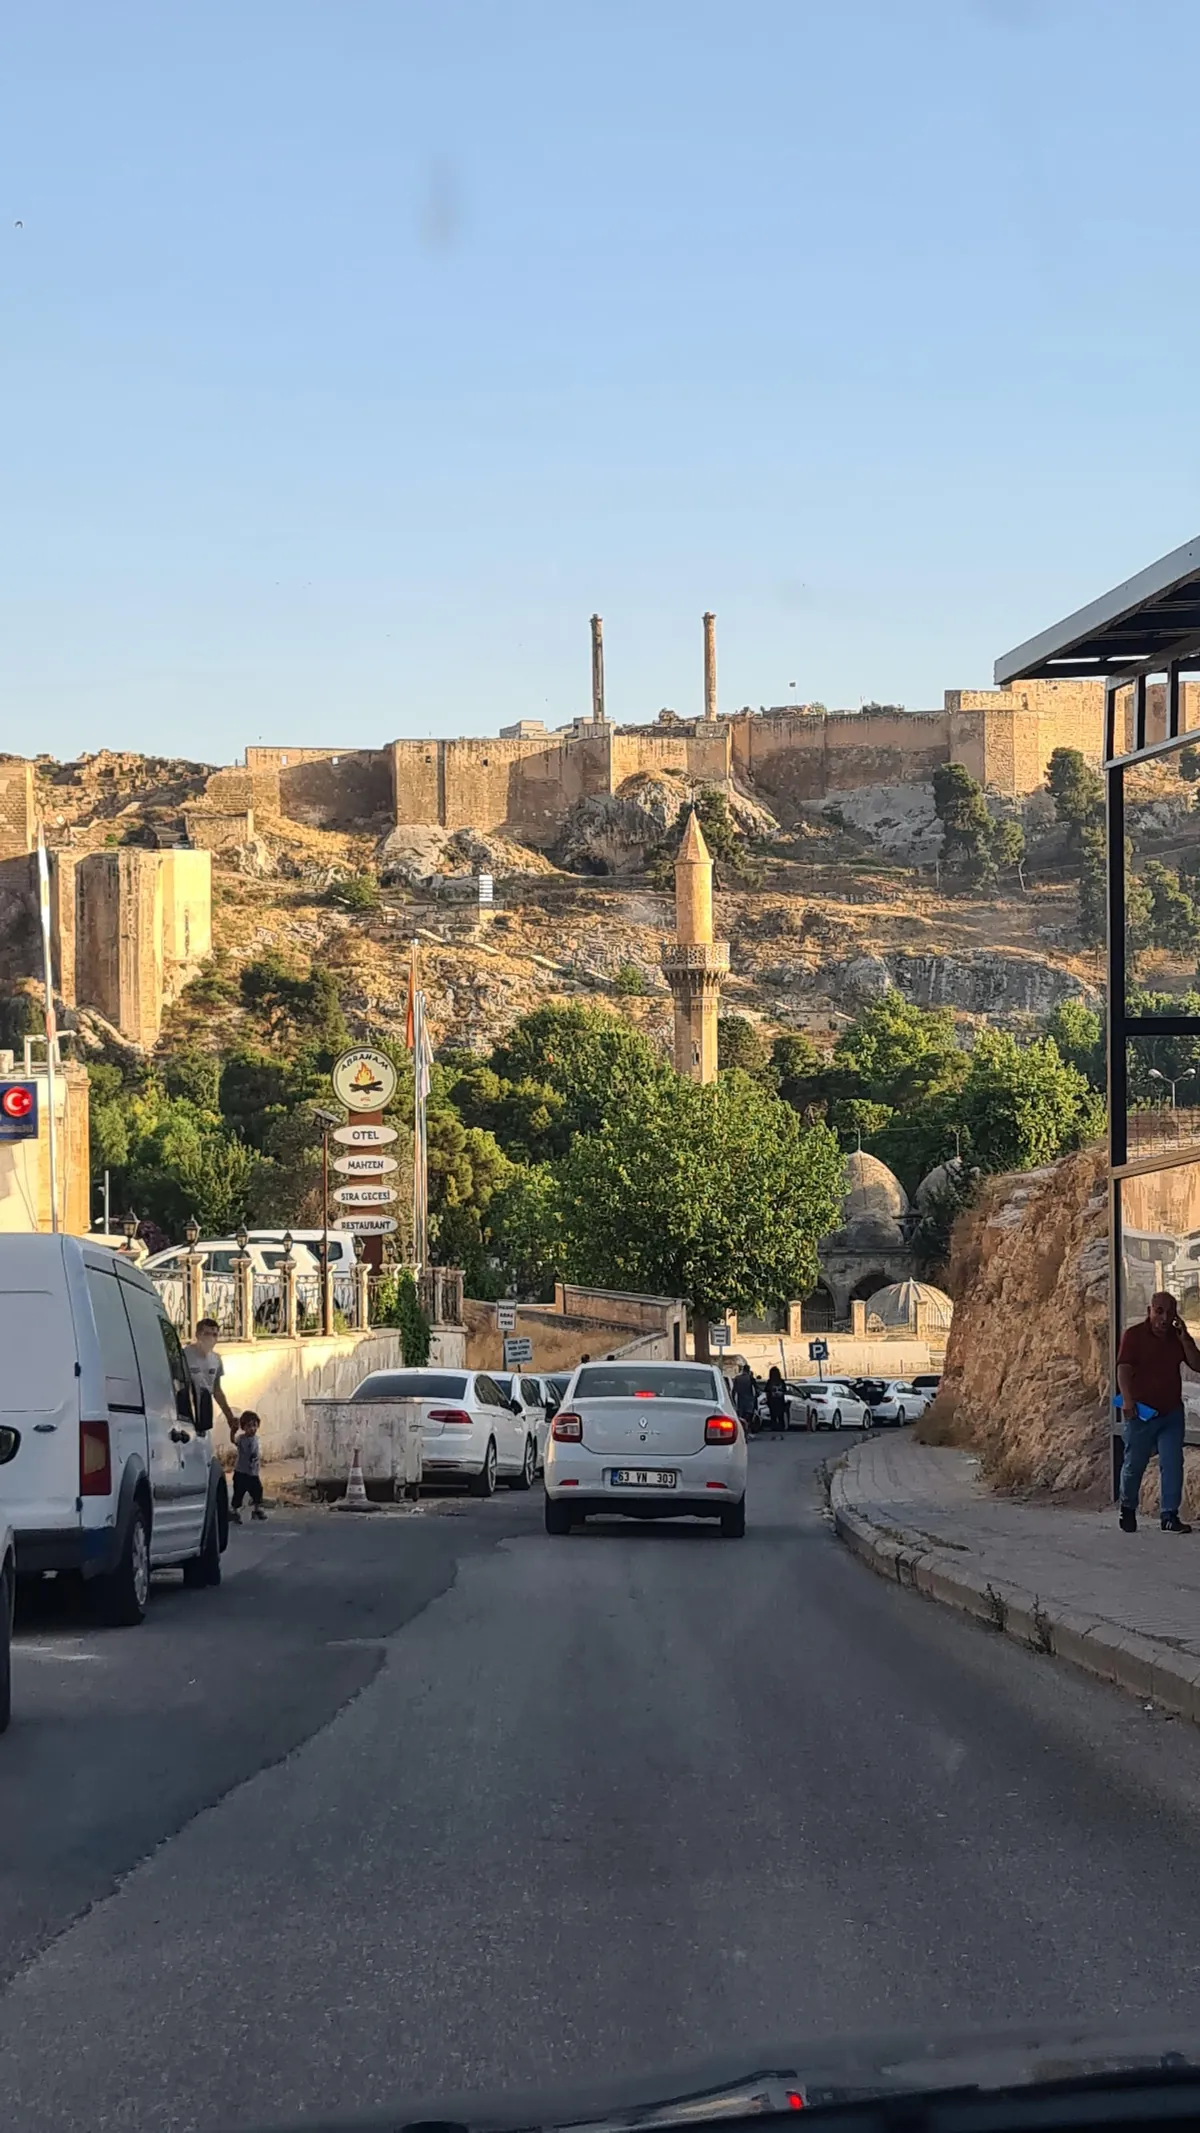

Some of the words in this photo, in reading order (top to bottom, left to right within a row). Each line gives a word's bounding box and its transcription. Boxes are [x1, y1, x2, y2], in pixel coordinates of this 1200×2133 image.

[341, 1053, 388, 1071] ABRAHAM
[352, 1130, 379, 1140] OTEL
[347, 1160, 384, 1170] MAHZEN
[341, 1192, 360, 1201] SIRA
[341, 1220, 391, 1230] RESTAURANT
[812, 1344, 824, 1358] P
[618, 1472, 629, 1481] 63
[656, 1473, 673, 1484] 303
